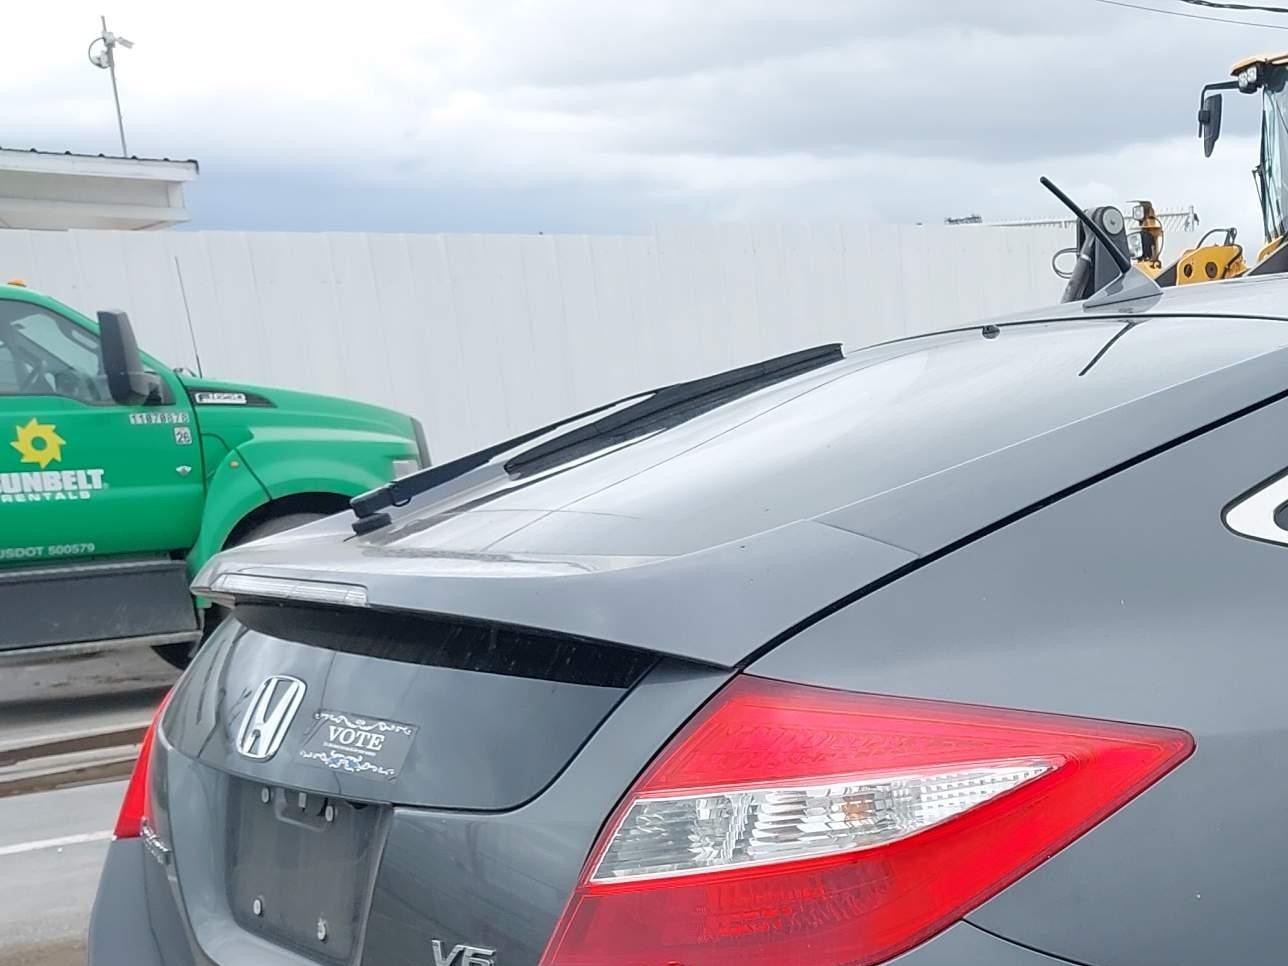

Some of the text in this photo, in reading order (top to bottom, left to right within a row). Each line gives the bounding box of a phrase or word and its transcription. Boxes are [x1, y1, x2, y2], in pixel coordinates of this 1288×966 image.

[0, 469, 104, 493] UNBELT
[1, 490, 91, 503] RENTALS
[329, 725, 385, 751] VOTE
